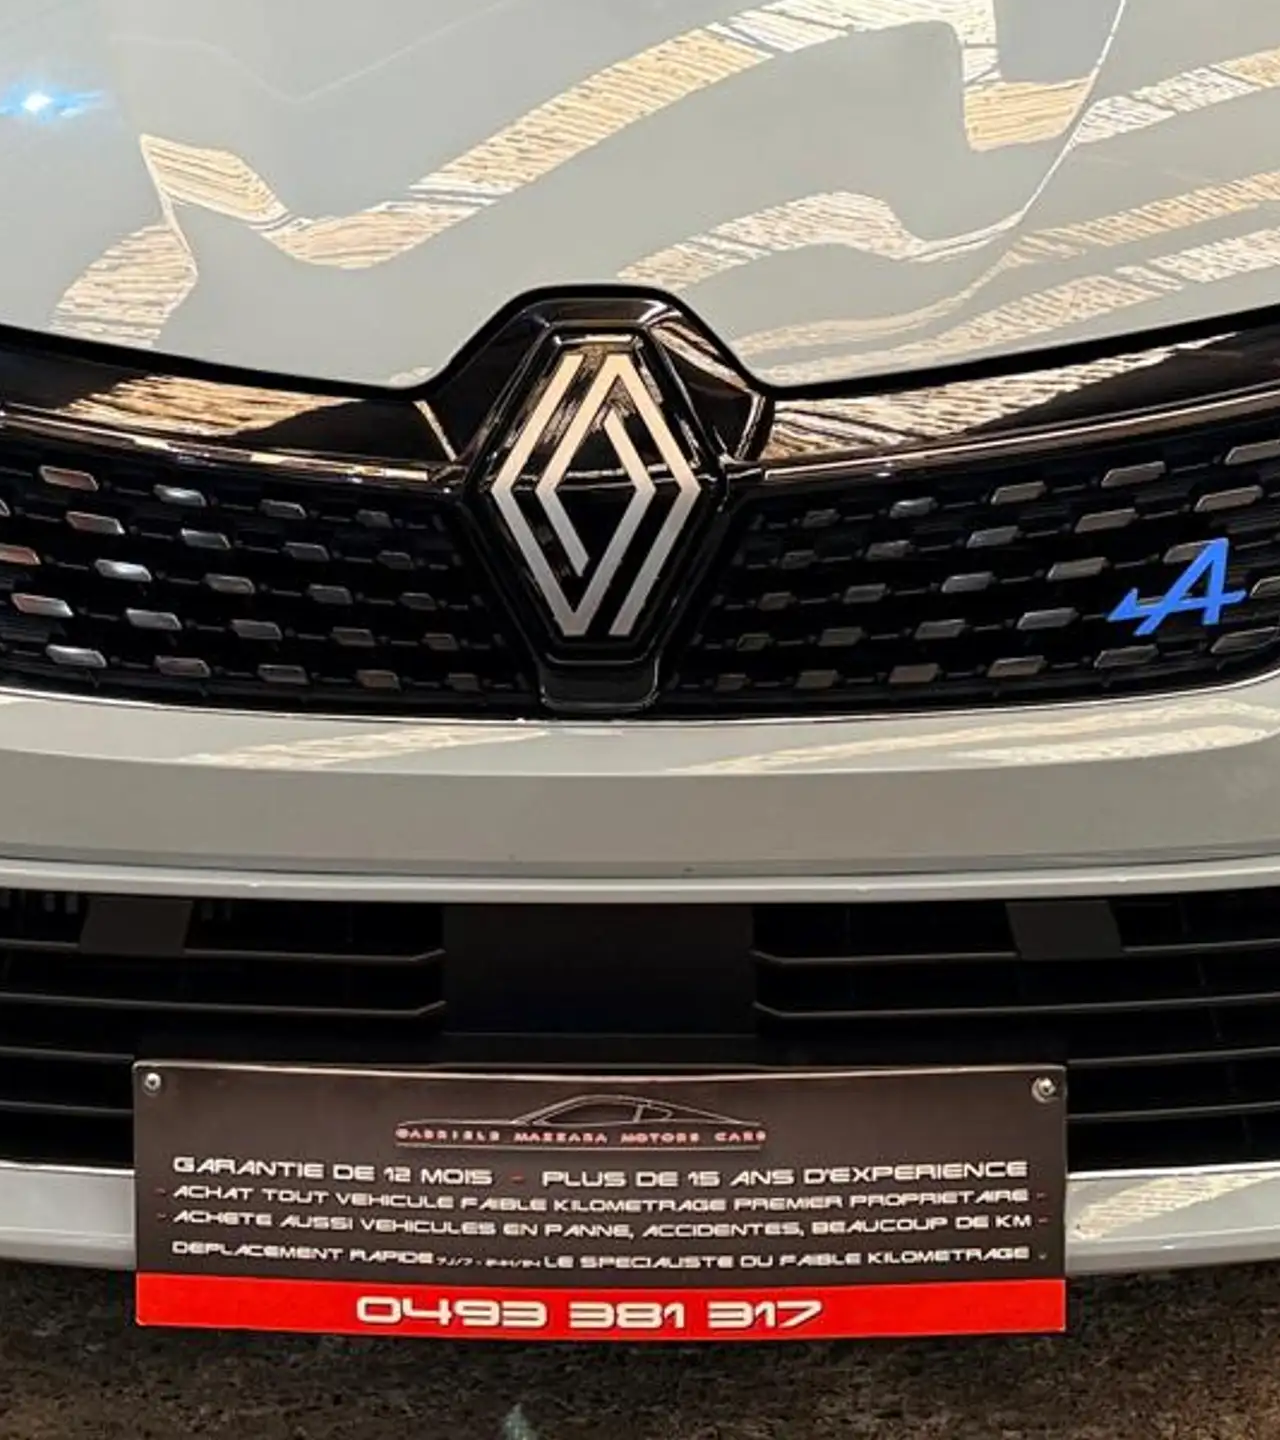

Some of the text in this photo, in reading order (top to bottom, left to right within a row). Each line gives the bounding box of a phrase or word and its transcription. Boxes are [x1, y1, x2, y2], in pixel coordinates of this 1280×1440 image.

[174, 1157, 1026, 1186] GARANTIE DE 12 MOIS PLUS DE 15 ANS D'EXPERIENCE
[174, 1186, 253, 1199] ACHAT
[262, 1189, 328, 1203] TOUT
[336, 1193, 453, 1208] VEHICULE
[554, 1200, 725, 1211] KILOMETRAGE
[734, 1196, 842, 1210] PREMIER
[850, 1190, 1028, 1207] PROPRIETAIRE
[174, 1211, 271, 1225] ACHETE
[281, 1215, 352, 1229] AUSSI
[361, 1219, 496, 1234] VEHICULES
[504, 1224, 537, 1235] EN
[812, 1218, 947, 1234] BEAUCOUP
[956, 1216, 988, 1228] DE
[996, 1215, 1030, 1227] KM
[173, 1242, 342, 1259] DEPLACEMENT
[350, 1250, 432, 1263] RAPIDE
[741, 1256, 772, 1267] DU
[868, 1248, 1028, 1263] KILOMETRAGE
[358, 1297, 820, 1327] 0493 381 317
